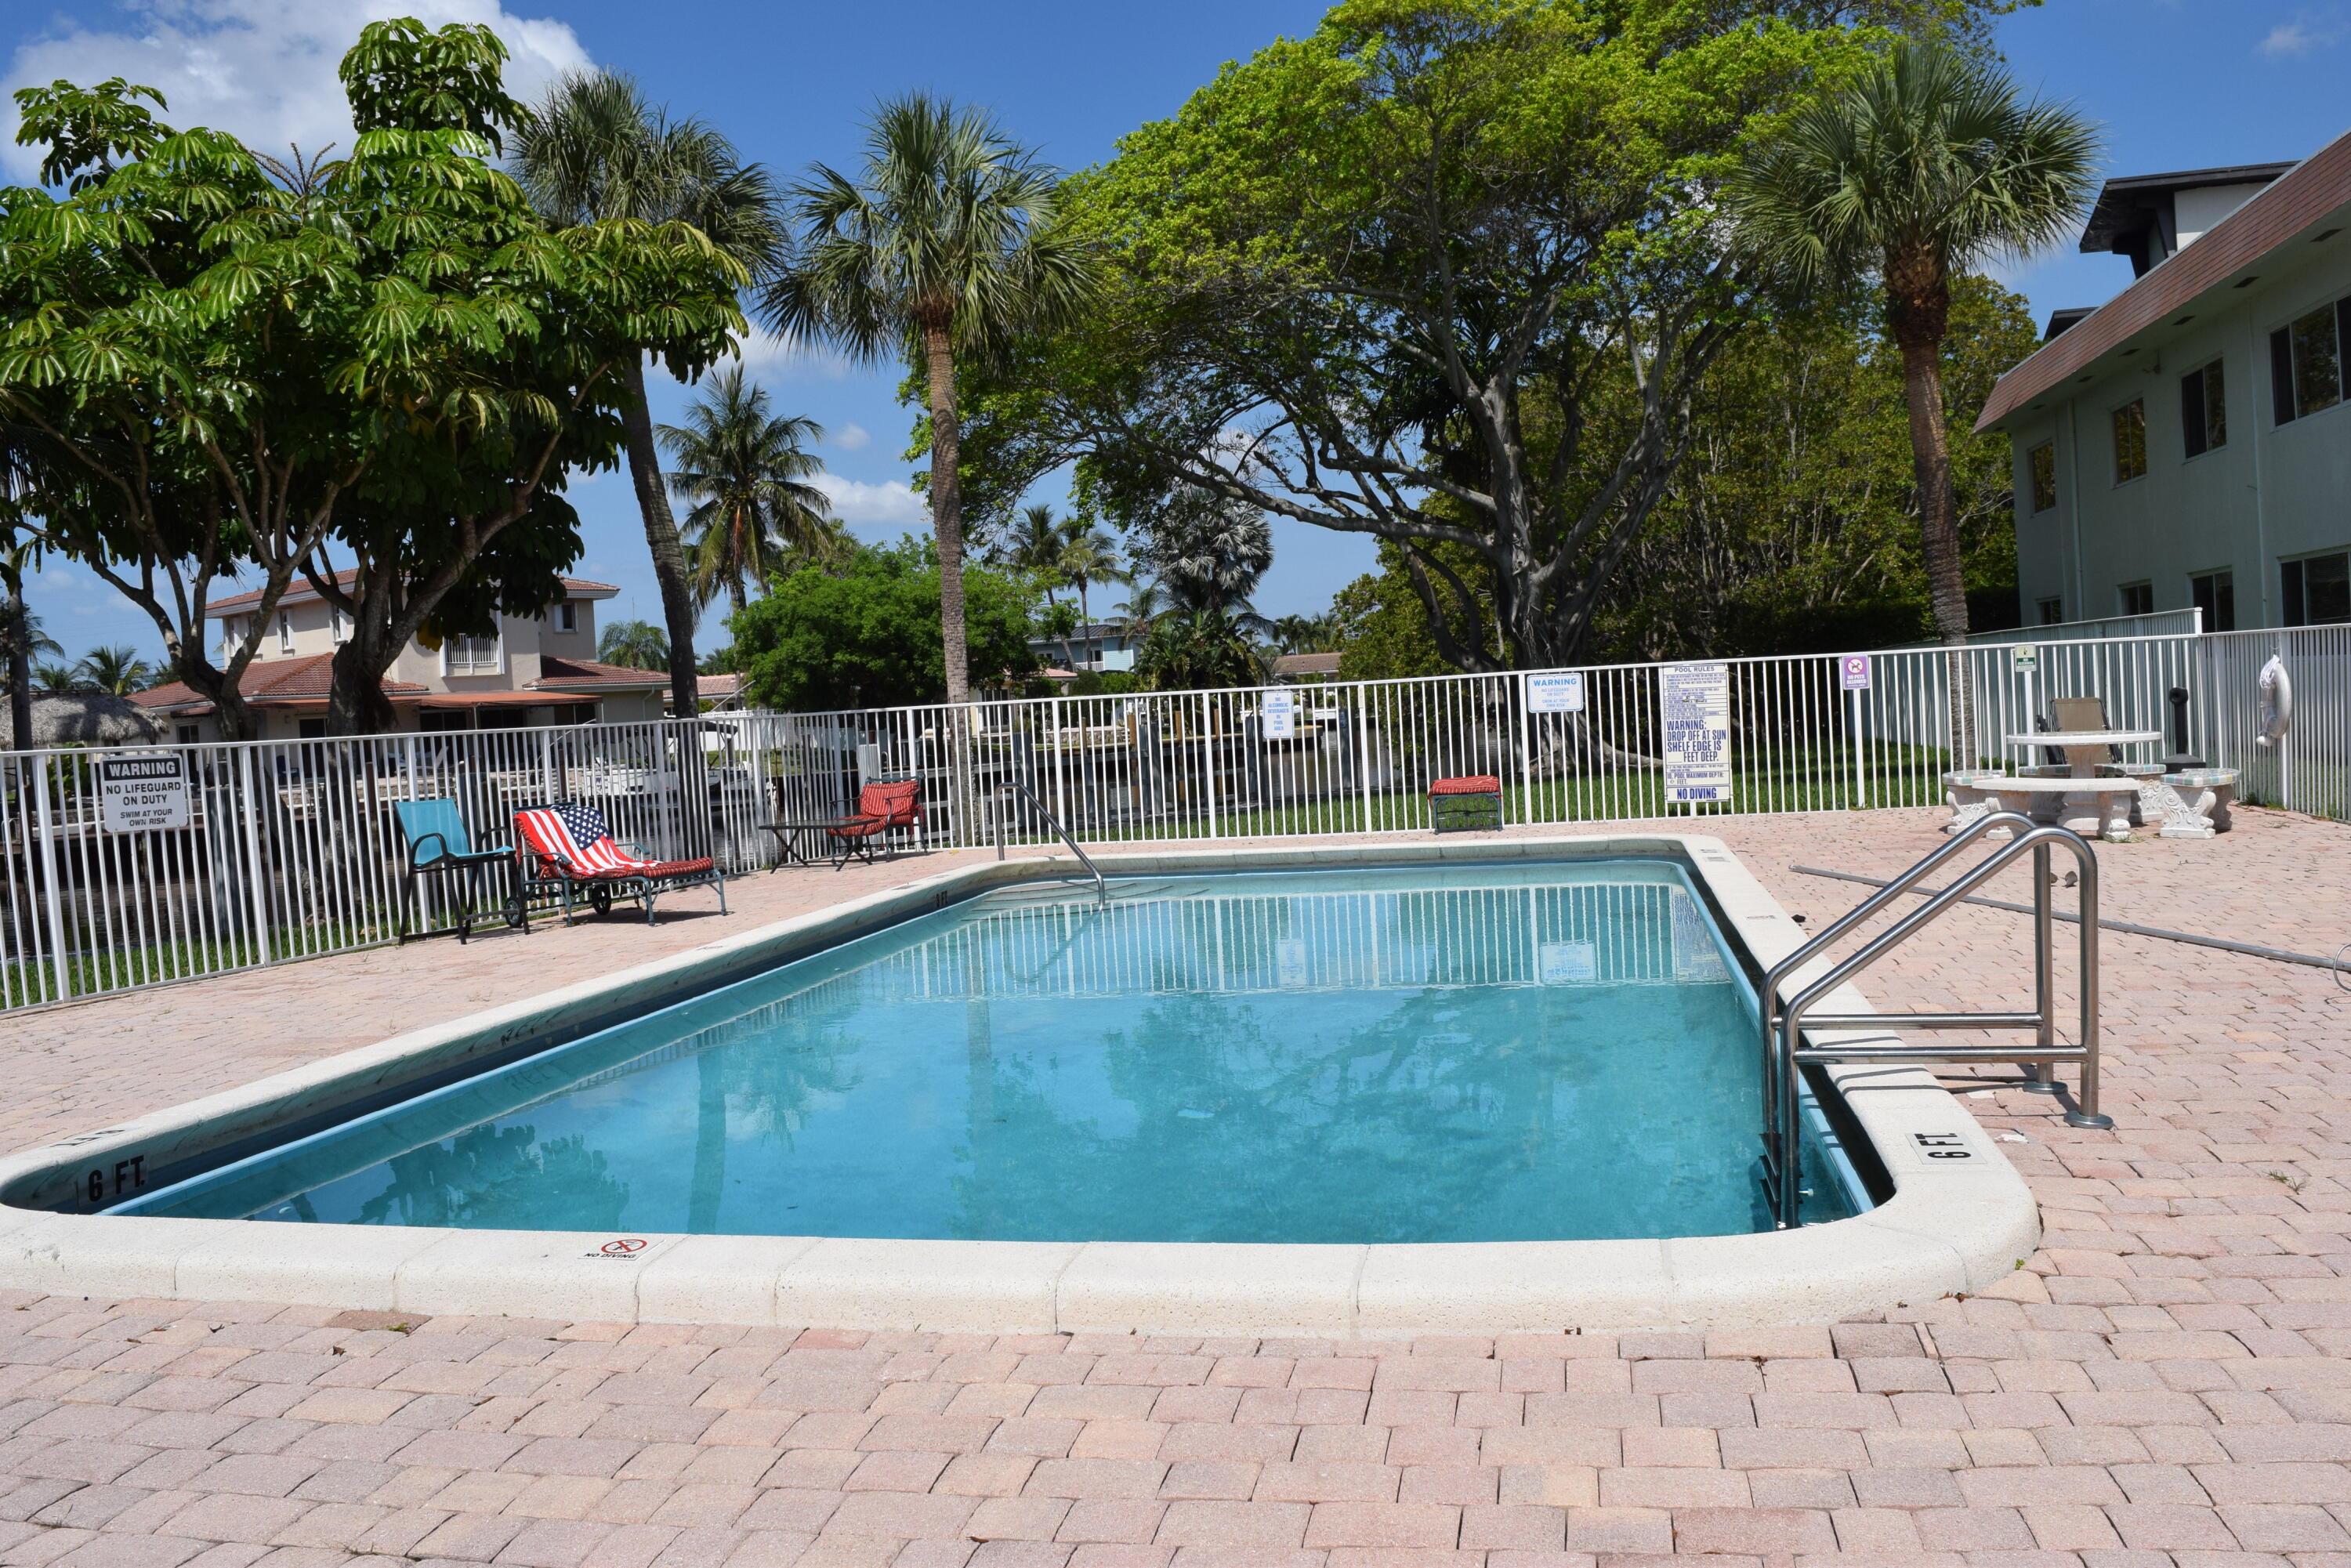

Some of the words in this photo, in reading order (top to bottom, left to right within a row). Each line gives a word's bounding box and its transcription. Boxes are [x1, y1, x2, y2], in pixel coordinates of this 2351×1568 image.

[1667, 719, 1707, 730] WARNING:
[1667, 731, 1686, 741] DROP
[1688, 730, 1700, 741] OFF
[1702, 730, 1711, 741] AT
[1712, 730, 1726, 741] SUN
[1668, 741, 1690, 752] SHELF
[1693, 741, 1712, 751] EDGE
[1714, 741, 1722, 751] IS
[1683, 751, 1699, 762] FEET
[1701, 751, 1719, 762] DEEP.
[109, 761, 176, 777] WARNING
[106, 785, 121, 795] NO
[125, 782, 181, 794] LIFEGUARD
[1677, 788, 1687, 799] NO
[1690, 788, 1717, 799] DIVING
[123, 796, 138, 806] ON
[142, 794, 167, 805] DUTY
[120, 810, 140, 819] SWIM
[1914, 1132, 1964, 1146] FT.
[88, 1169, 103, 1202] 6
[115, 1154, 145, 1195] FT.
